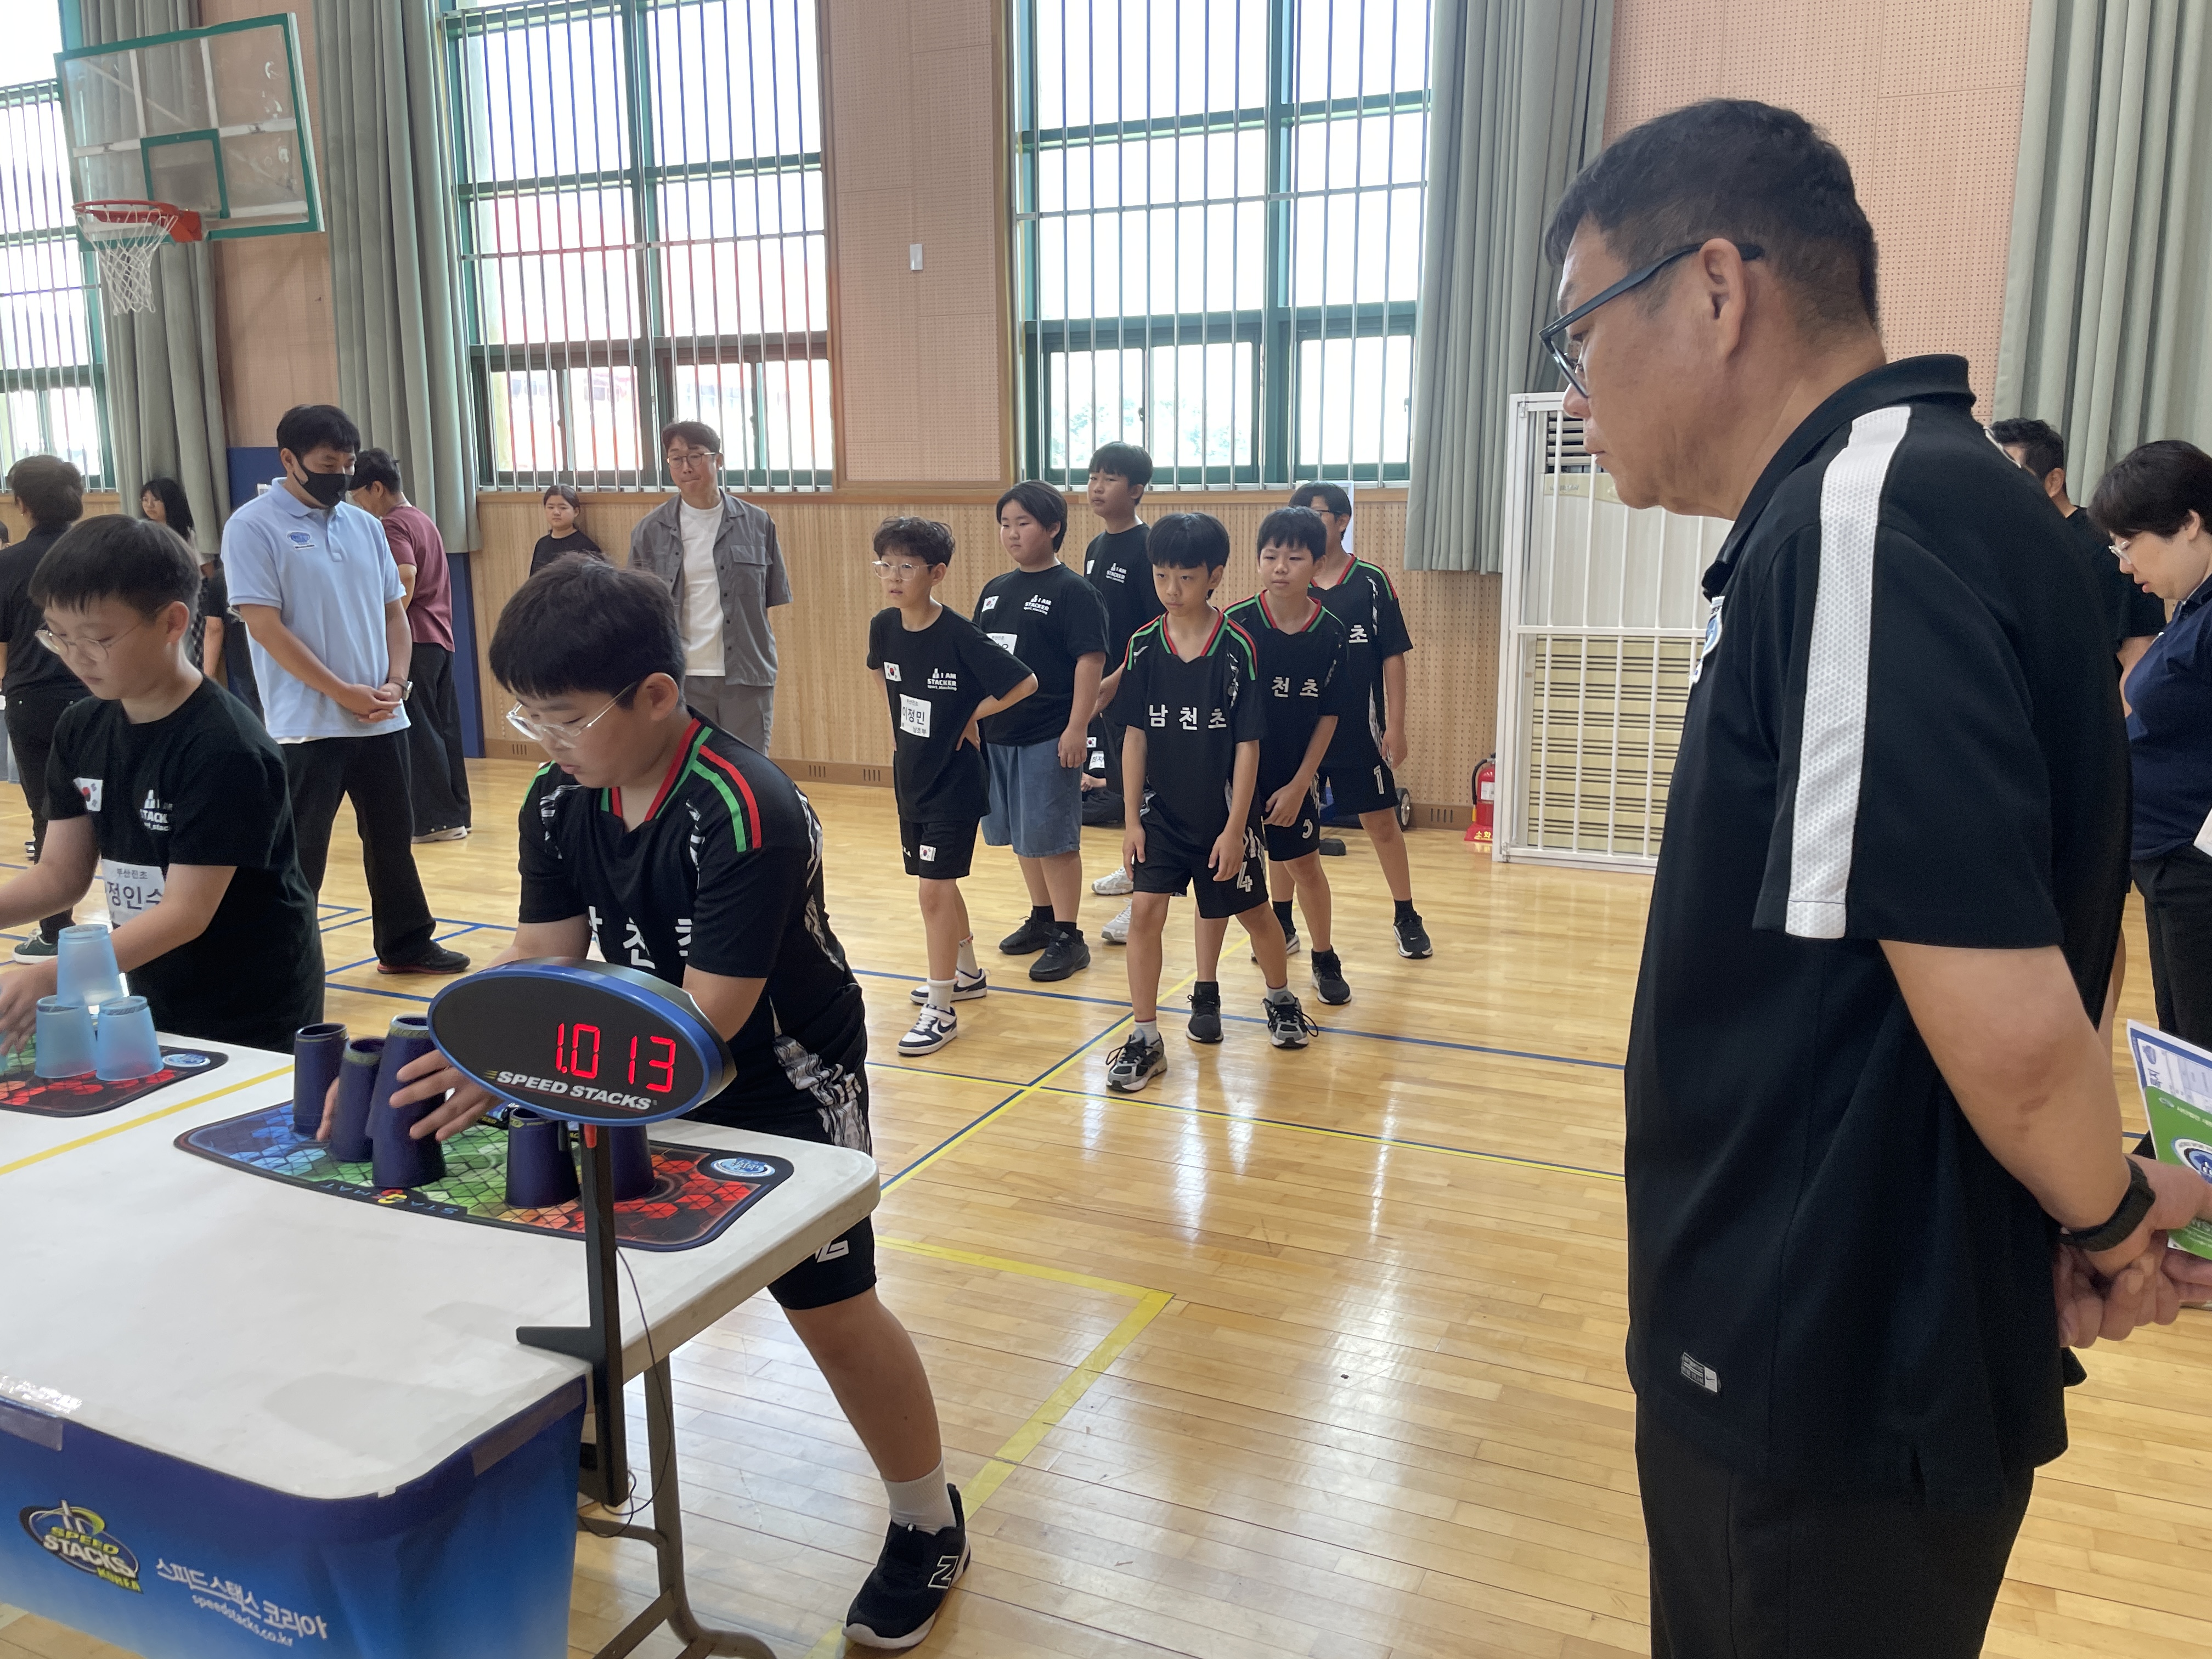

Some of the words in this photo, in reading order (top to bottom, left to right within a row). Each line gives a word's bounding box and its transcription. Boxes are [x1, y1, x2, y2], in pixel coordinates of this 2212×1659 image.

[927, 678, 957, 686] STACKER
[902, 706, 925, 725] 이정민
[496, 1070, 569, 1094] SPEED
[569, 1085, 652, 1110] STACKS
[43, 1534, 136, 1578] STACKS
[51, 1527, 119, 1555] SPEED
[263, 1599, 328, 1640] 코리아
